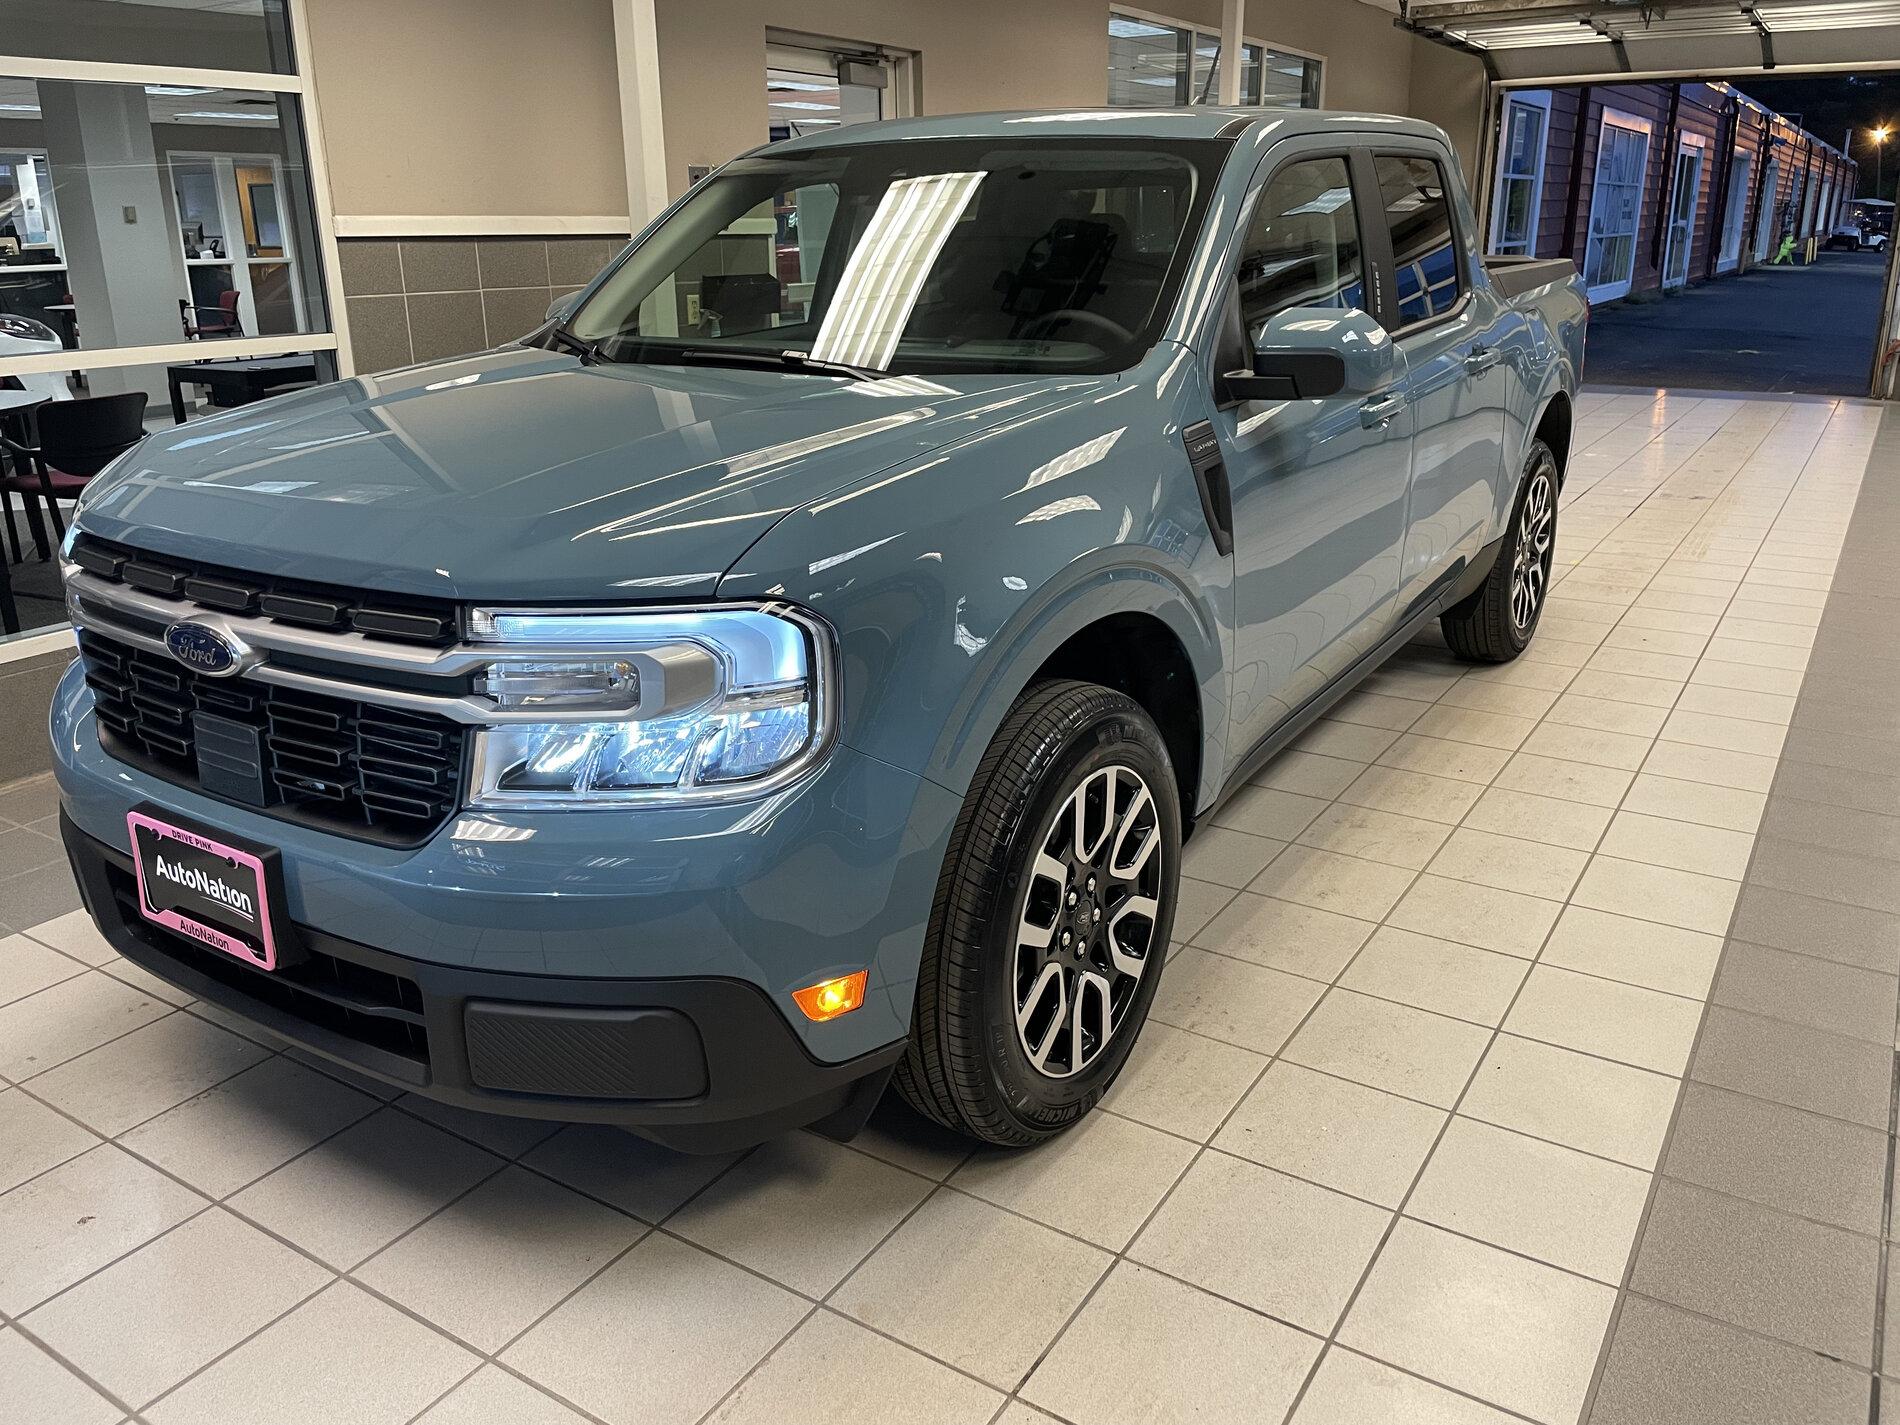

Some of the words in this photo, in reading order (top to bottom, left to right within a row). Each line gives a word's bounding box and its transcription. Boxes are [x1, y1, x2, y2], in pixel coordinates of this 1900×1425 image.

[178, 634, 216, 666] Ford
[171, 829, 194, 844] DRIVE
[195, 838, 213, 851] PINK
[156, 854, 253, 914] AutoNation
[180, 919, 230, 951] AutoNation
